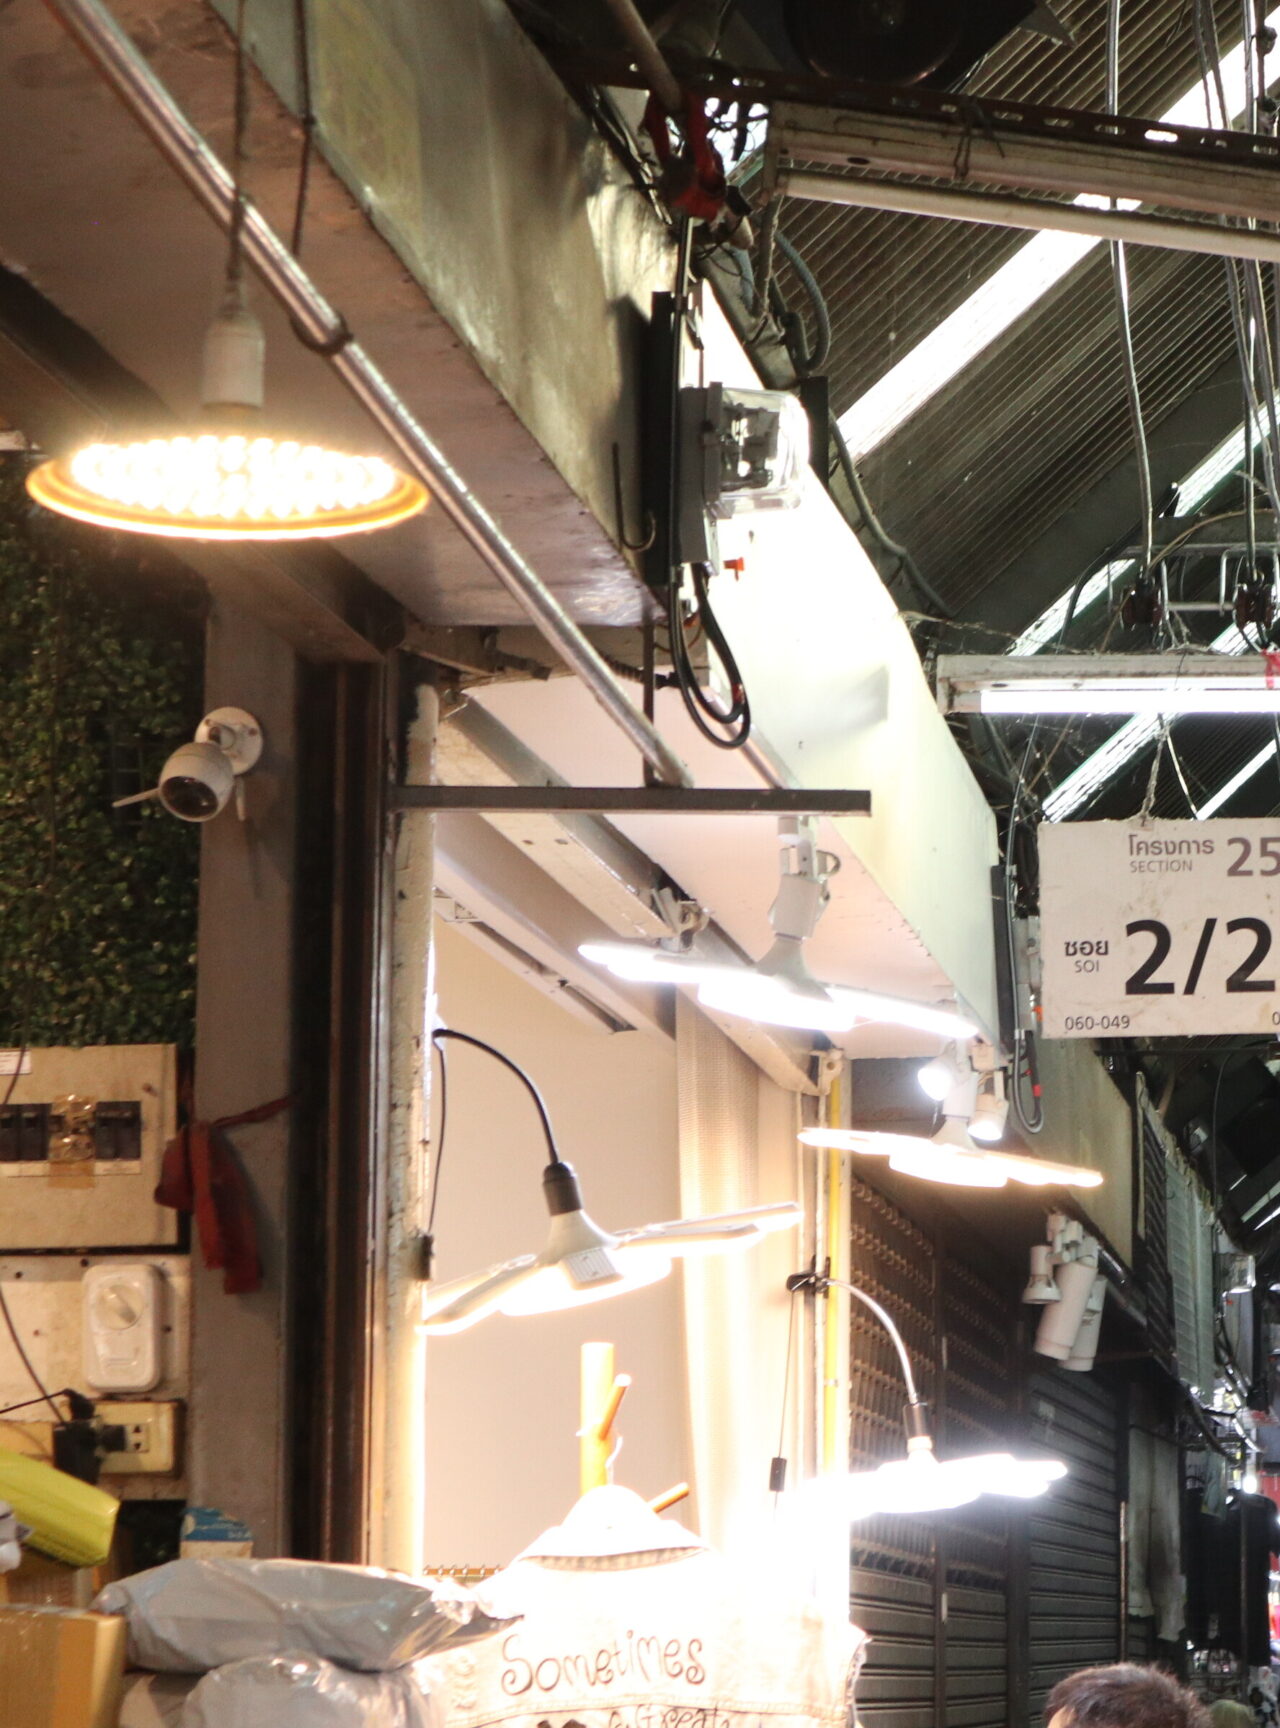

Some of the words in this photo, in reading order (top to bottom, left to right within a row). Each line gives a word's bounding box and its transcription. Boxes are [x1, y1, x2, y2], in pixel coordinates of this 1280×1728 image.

[1128, 834, 1215, 857] โครงการ
[1130, 859, 1193, 873] SECTION
[1074, 959, 1099, 973] SOI
[1125, 917, 1276, 996] 2/2
[1065, 1014, 1131, 1031] 060-049
[501, 1630, 706, 1696] Sometimes
